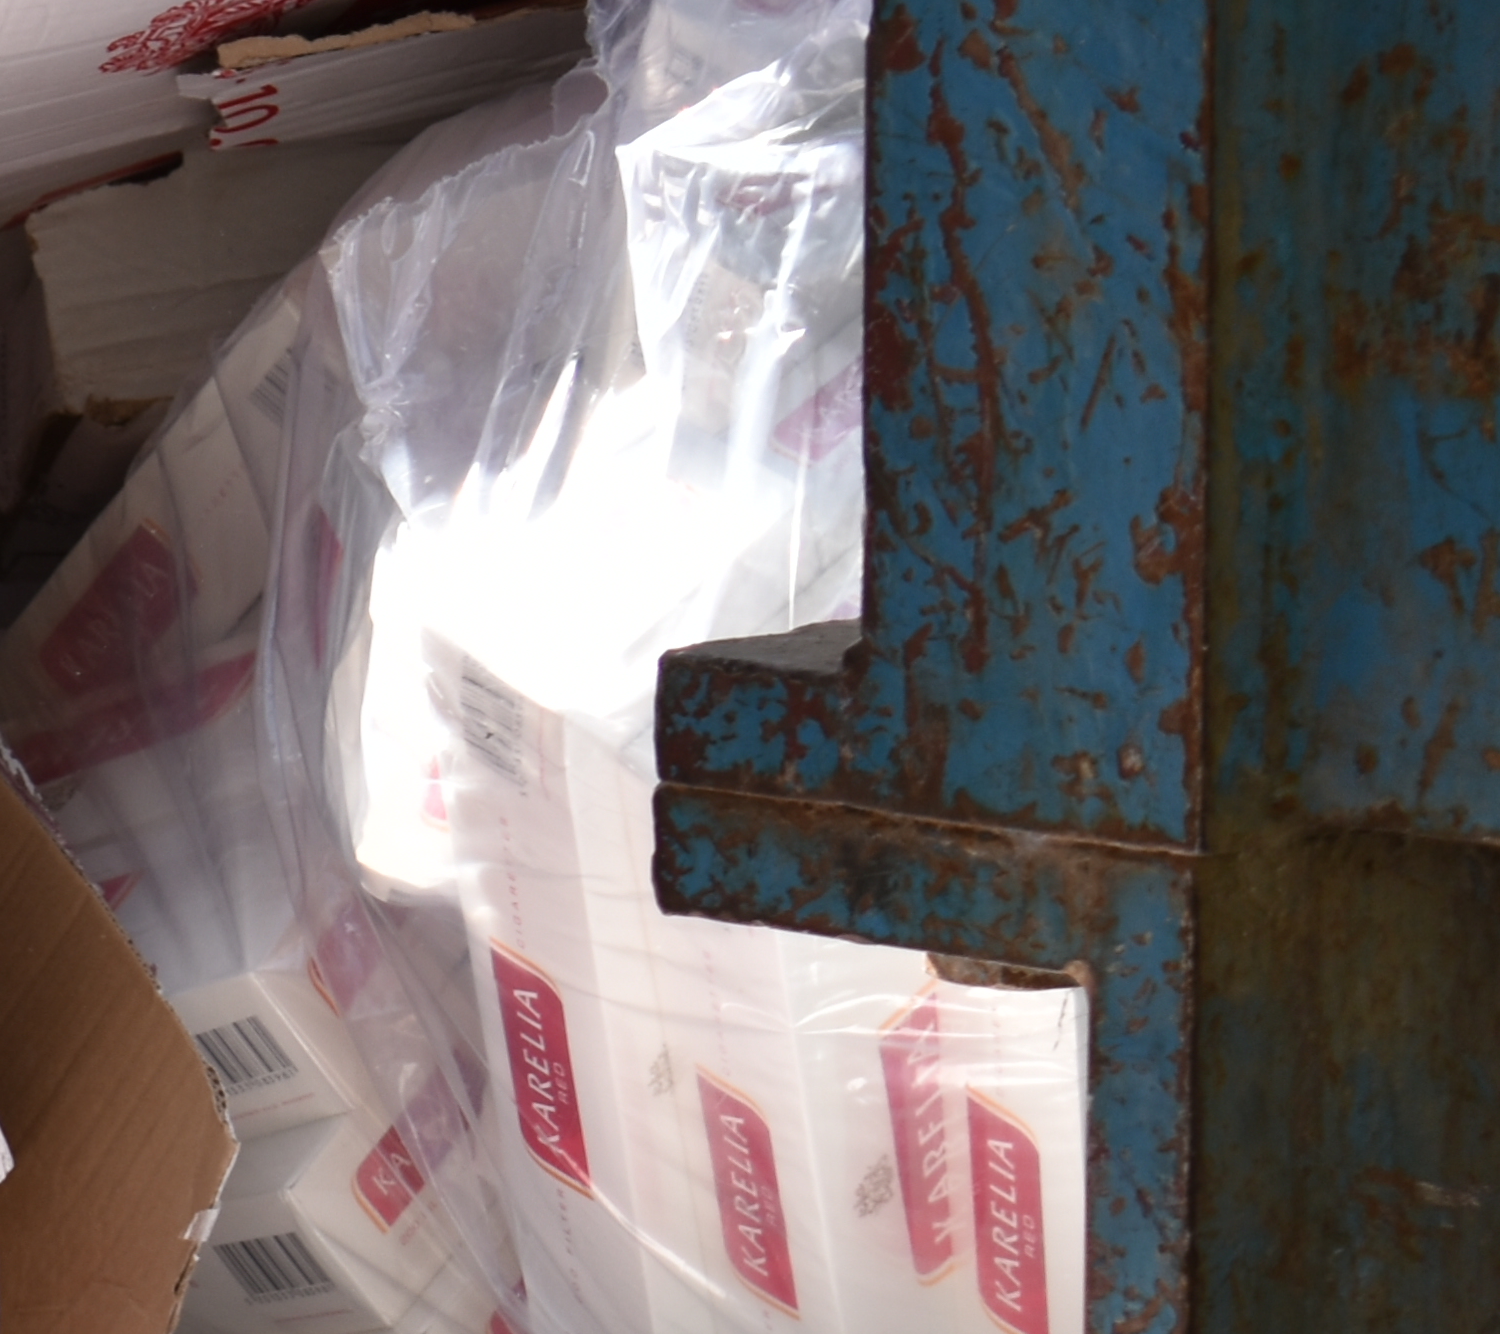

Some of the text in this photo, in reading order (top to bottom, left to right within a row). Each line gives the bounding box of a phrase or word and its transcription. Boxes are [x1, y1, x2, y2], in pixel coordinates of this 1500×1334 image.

[512, 987, 563, 1149] KARELIA
[719, 1112, 771, 1277] KARELIA
[993, 1137, 1025, 1313] KARELIA
